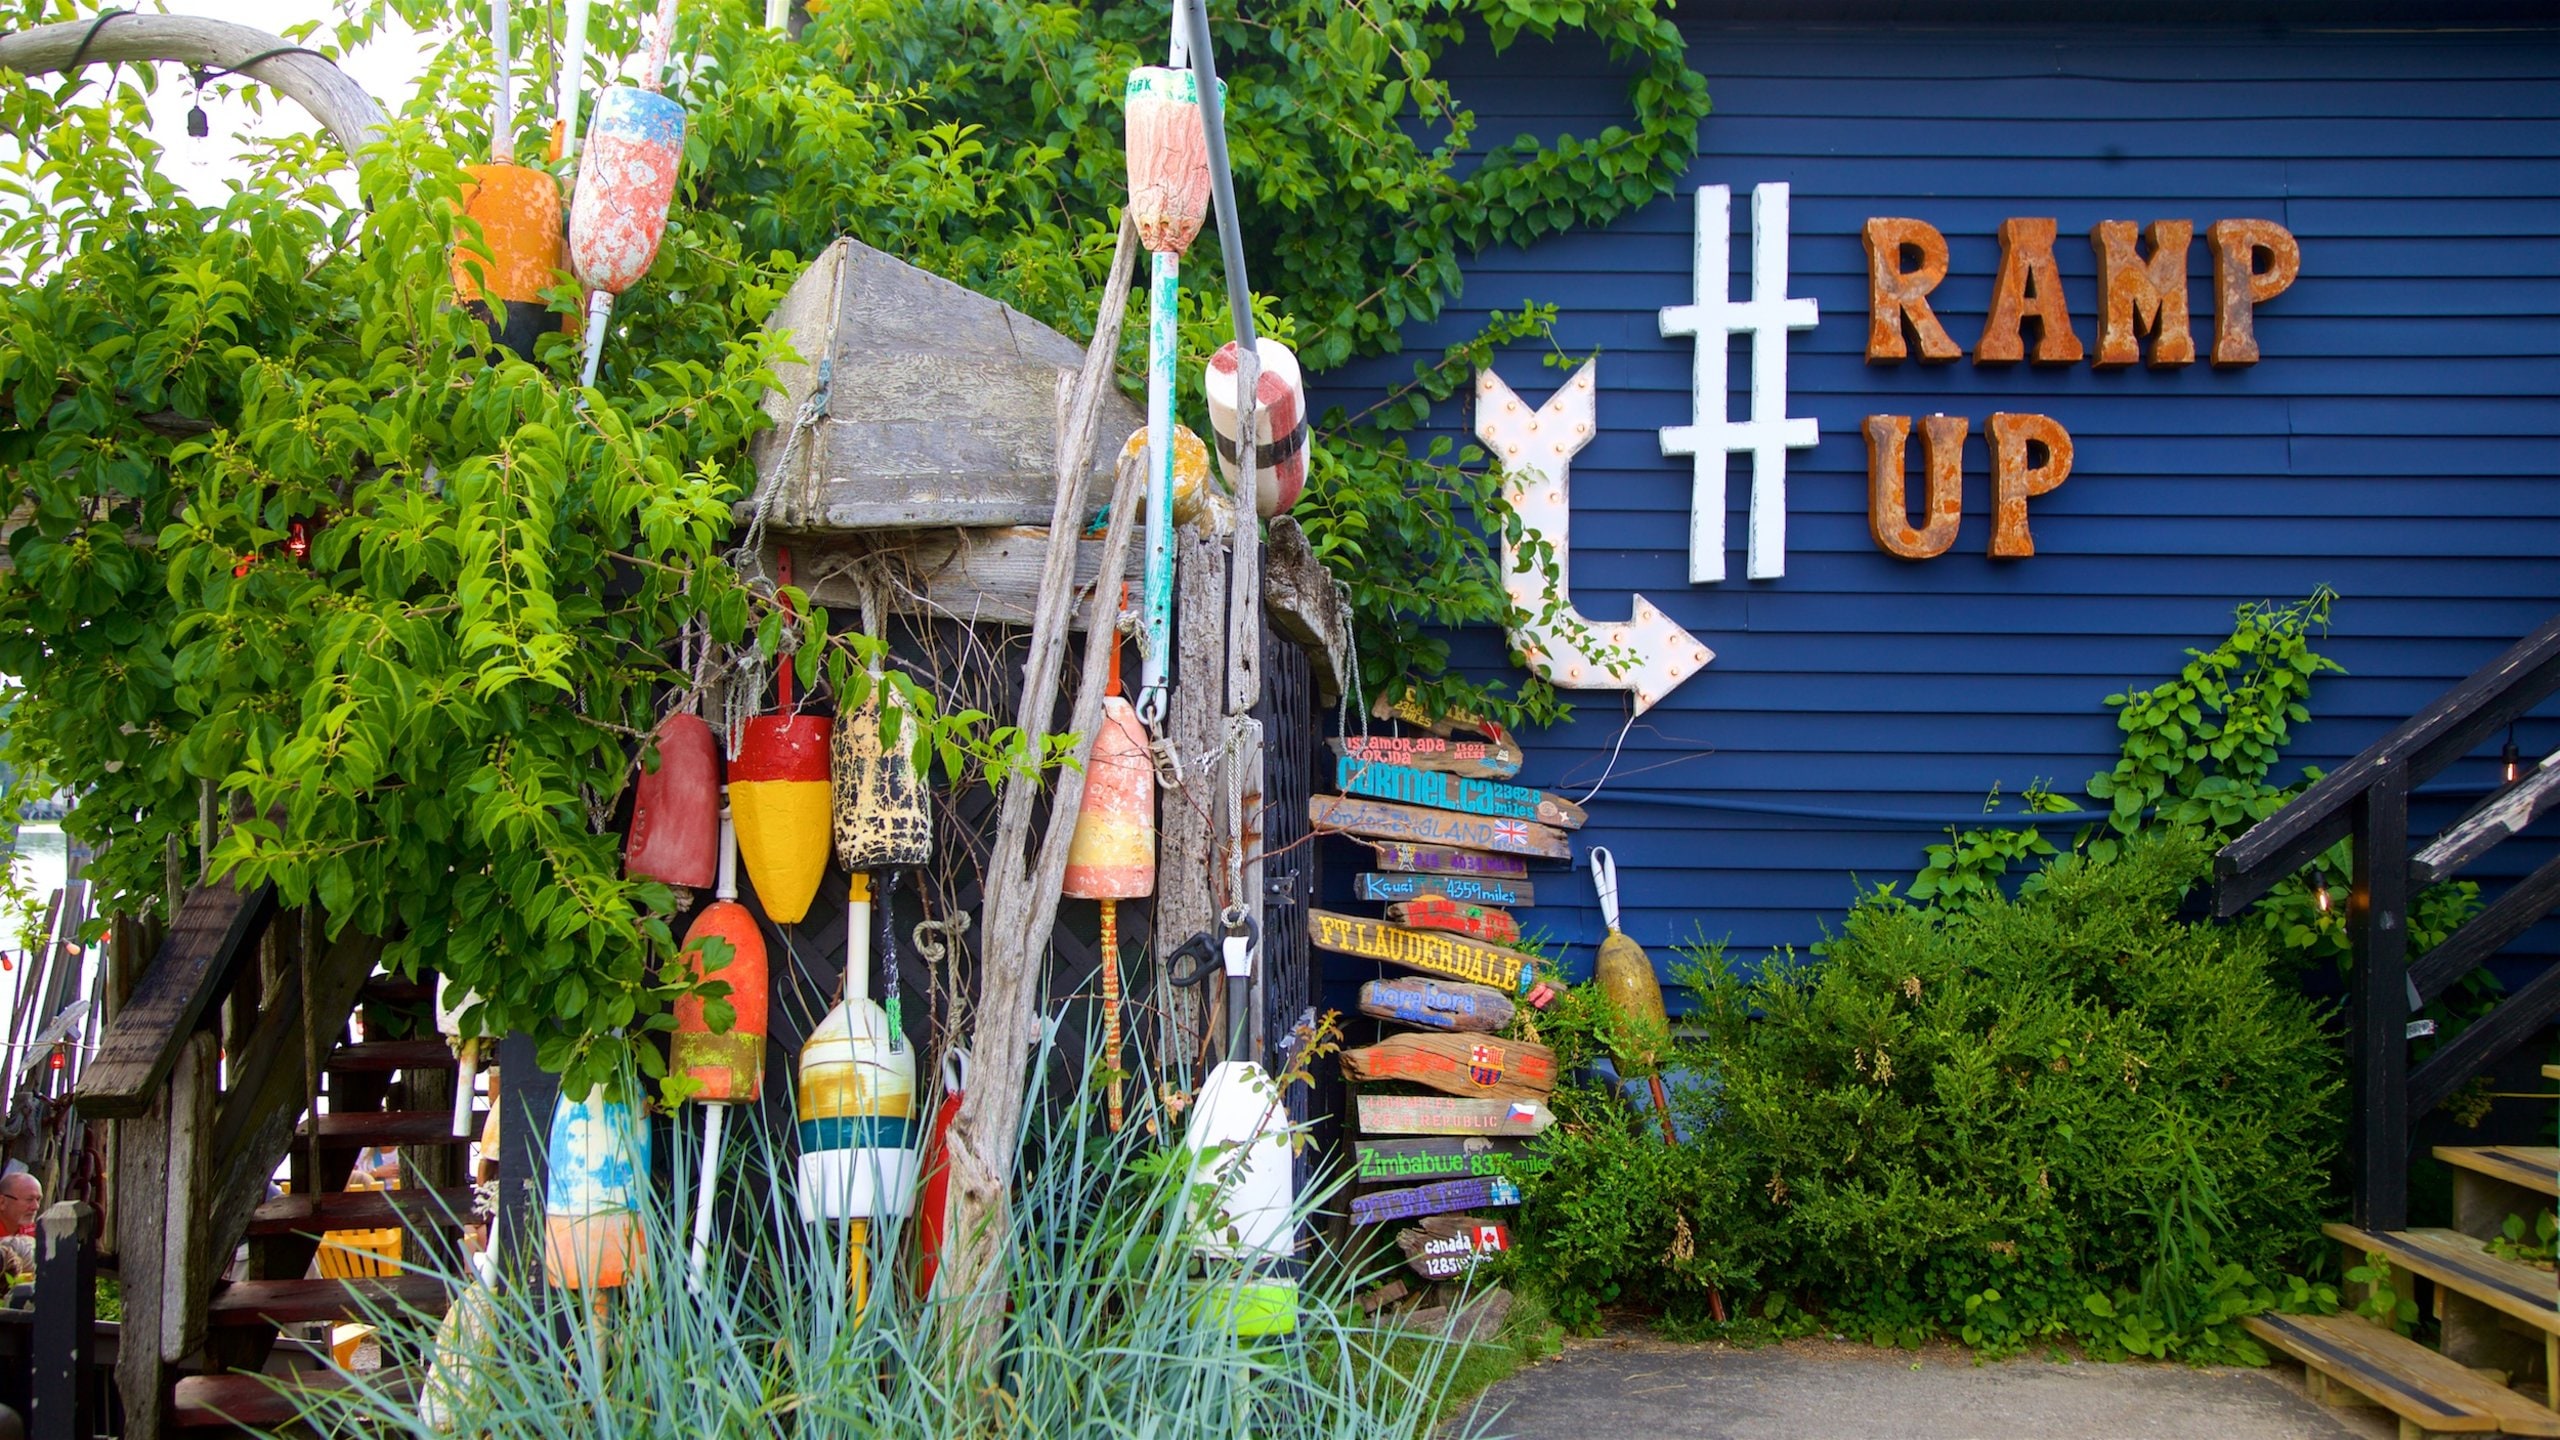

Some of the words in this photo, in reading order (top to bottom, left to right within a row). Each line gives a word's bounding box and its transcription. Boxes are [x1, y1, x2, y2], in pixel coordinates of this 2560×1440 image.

[1861, 216, 2300, 369] RAMP
[1861, 413, 2074, 560] UP
[1400, 711, 1432, 728] MILES
[1494, 801, 1536, 819] miles
[1366, 872, 1413, 900] Kauai
[1446, 879, 1481, 899] 4359
[1481, 883, 1516, 904] miles
[1355, 923, 1522, 992] LAUDERDALE
[1419, 1114, 1498, 1129] REPUBLIC
